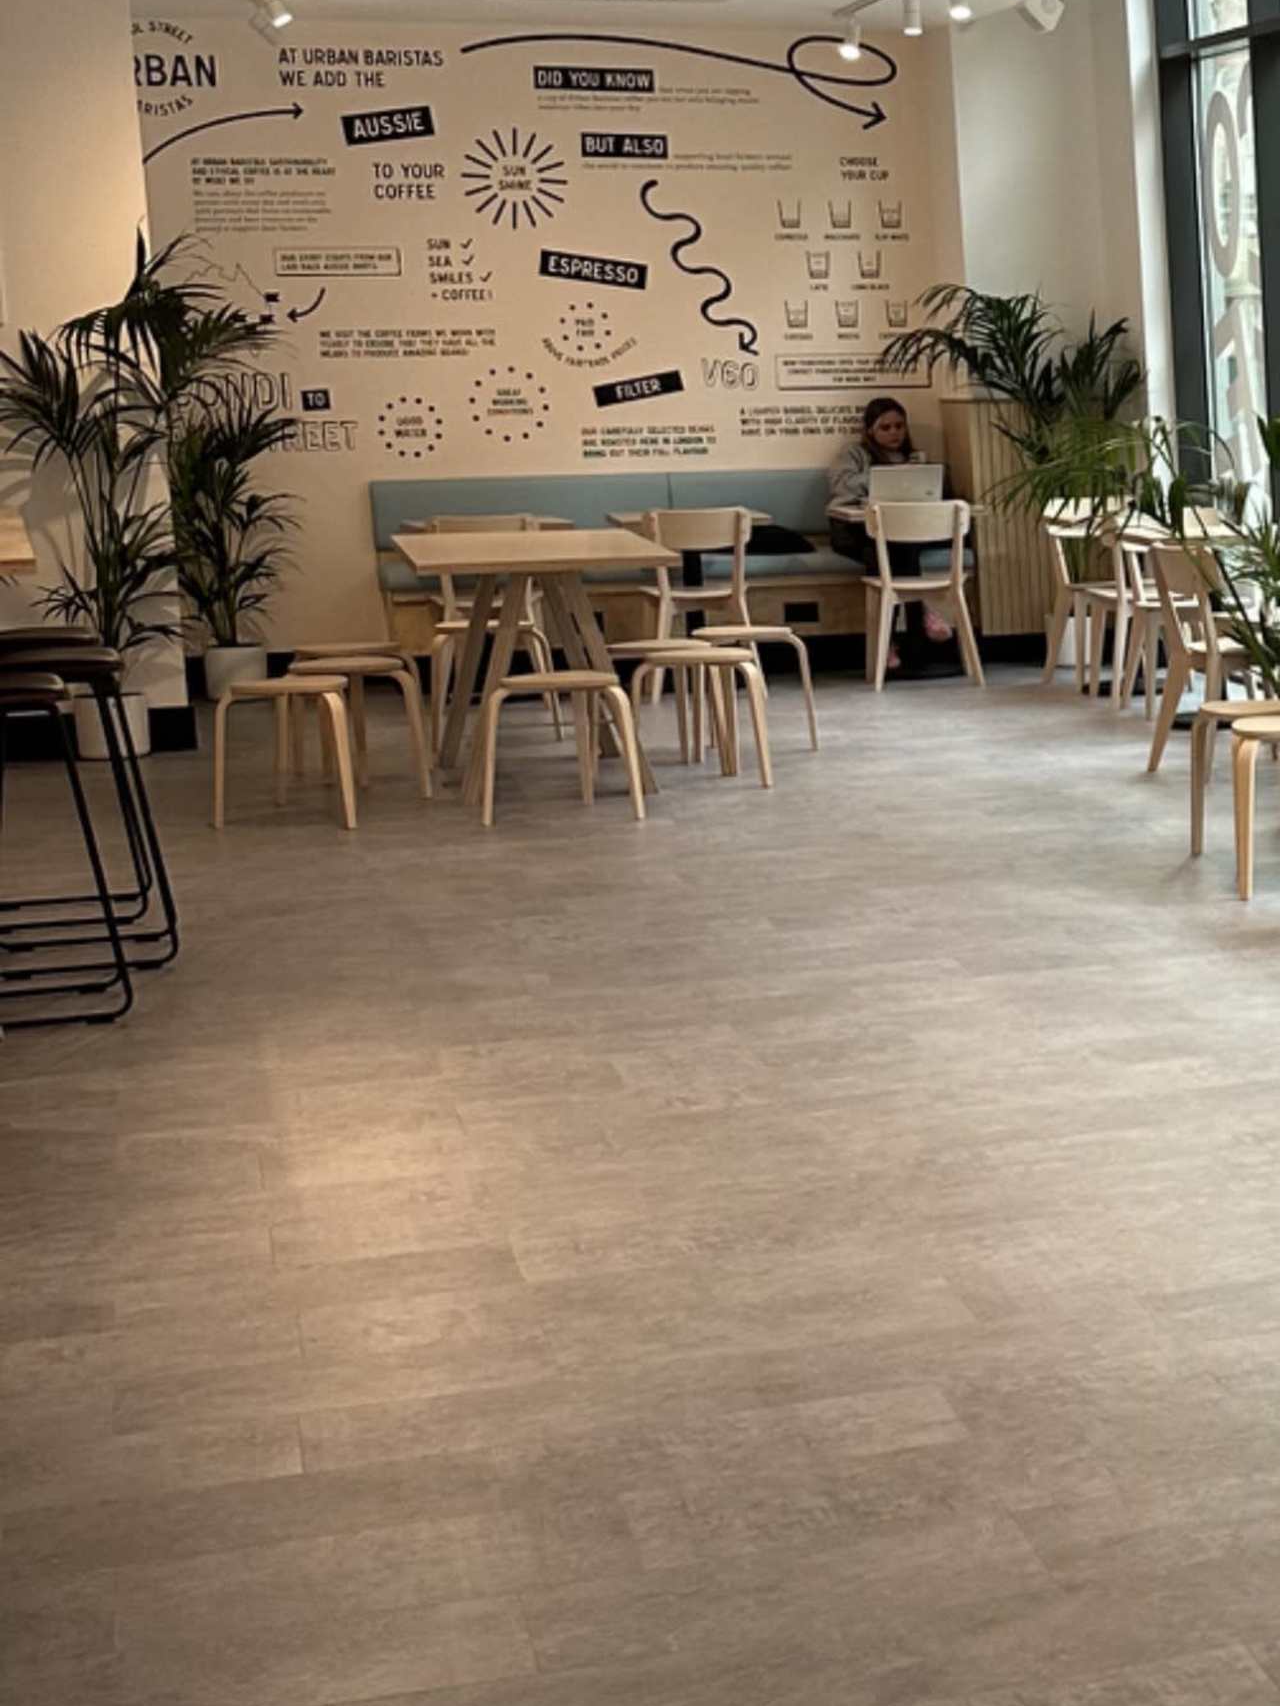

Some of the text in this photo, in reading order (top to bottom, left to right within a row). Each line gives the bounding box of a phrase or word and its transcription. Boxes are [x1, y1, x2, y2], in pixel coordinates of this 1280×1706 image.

[148, 21, 193, 44] STREET
[278, 48, 444, 67] AT URBAN BARISTAS
[279, 70, 386, 88] WE ADD THE
[537, 70, 651, 90] DID YOU KNOW
[352, 110, 425, 139] AUSSIE
[584, 136, 664, 155] BUT ALSO
[373, 163, 445, 179] TO YOUR
[502, 165, 526, 177] SUN
[840, 170, 889, 182] YOUR CUP
[374, 184, 435, 200] COFFEE
[498, 180, 533, 191] SHINE
[426, 238, 451, 250] SUN
[428, 255, 453, 268] SEA
[547, 254, 639, 284] ESPRESSO
[429, 271, 474, 285] SMILES
[701, 357, 759, 391] V60
[615, 378, 662, 400] FILTER
[306, 392, 326, 408] TO
